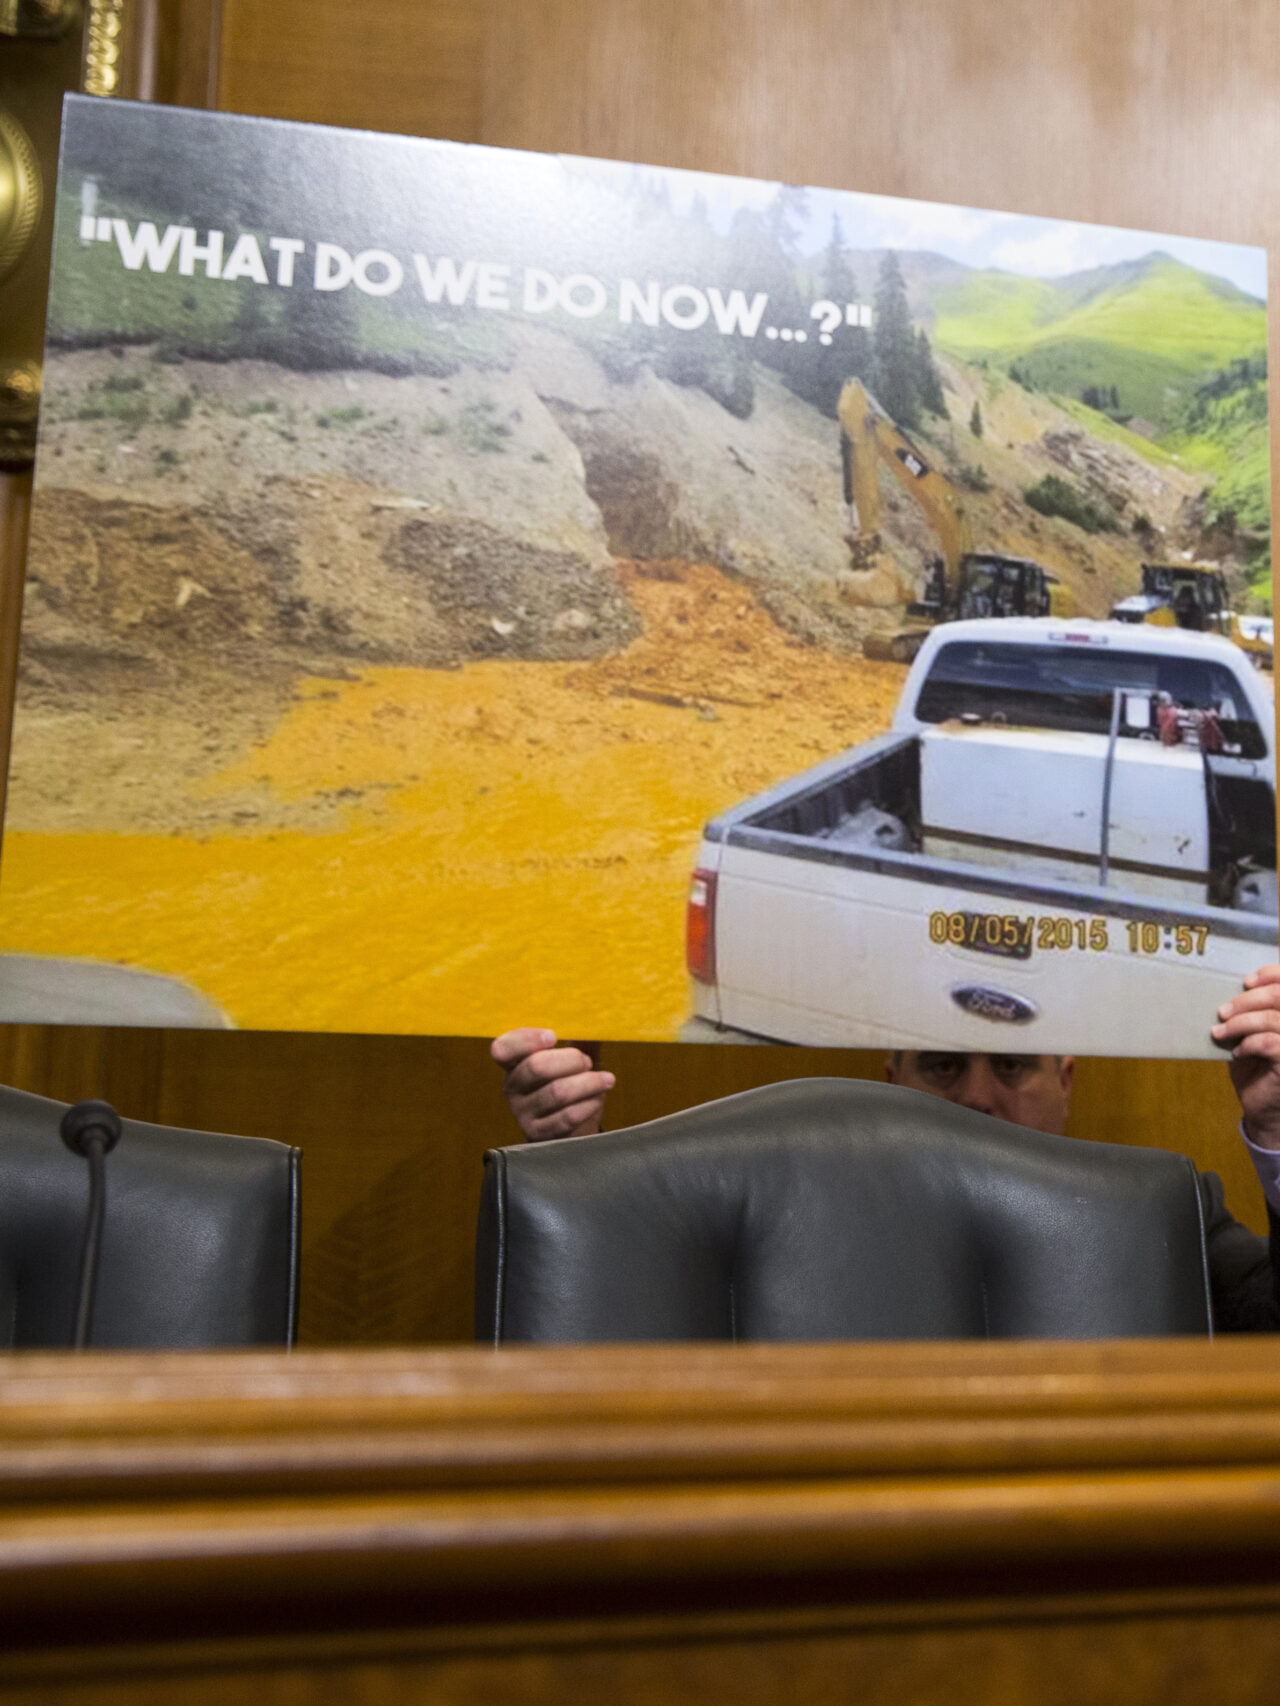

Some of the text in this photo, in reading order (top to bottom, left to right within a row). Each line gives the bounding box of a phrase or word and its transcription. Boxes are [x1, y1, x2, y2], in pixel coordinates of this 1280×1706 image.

[314, 242, 404, 297] DO
[413, 253, 511, 312] WE
[522, 267, 607, 319] DO
[929, 911, 1210, 956] 08/05/2015 10:57
